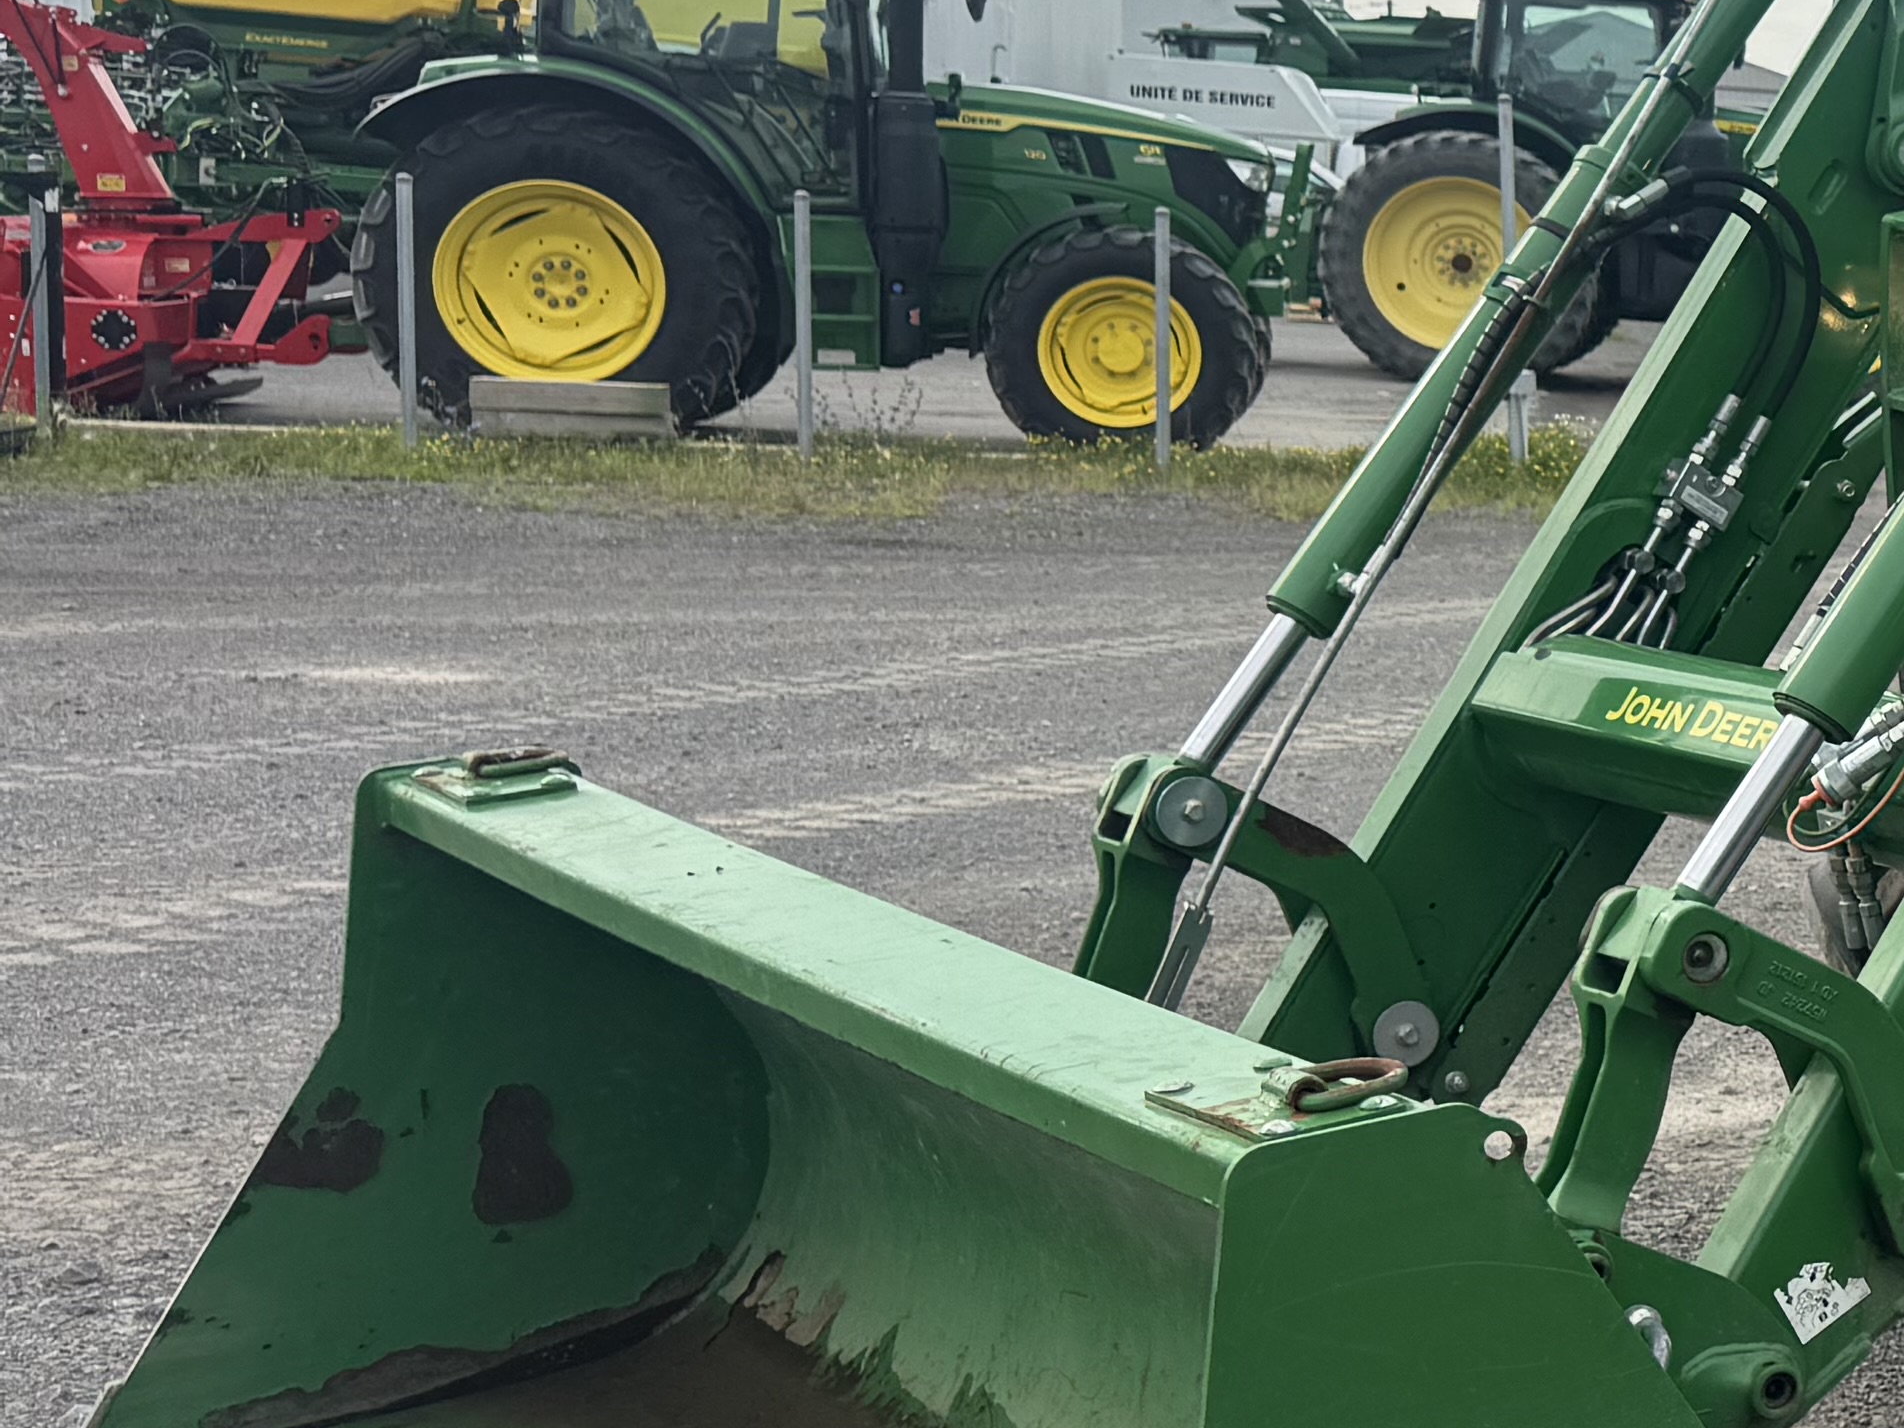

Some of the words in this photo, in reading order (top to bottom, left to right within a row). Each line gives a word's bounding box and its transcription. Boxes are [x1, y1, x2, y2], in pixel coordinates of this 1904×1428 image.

[1130, 84, 1177, 102] UNITÉ
[1182, 88, 1204, 103] DE
[1208, 90, 1275, 109] SERVICE
[1605, 686, 1695, 734] JOHN
[1688, 699, 1780, 752] DEER
